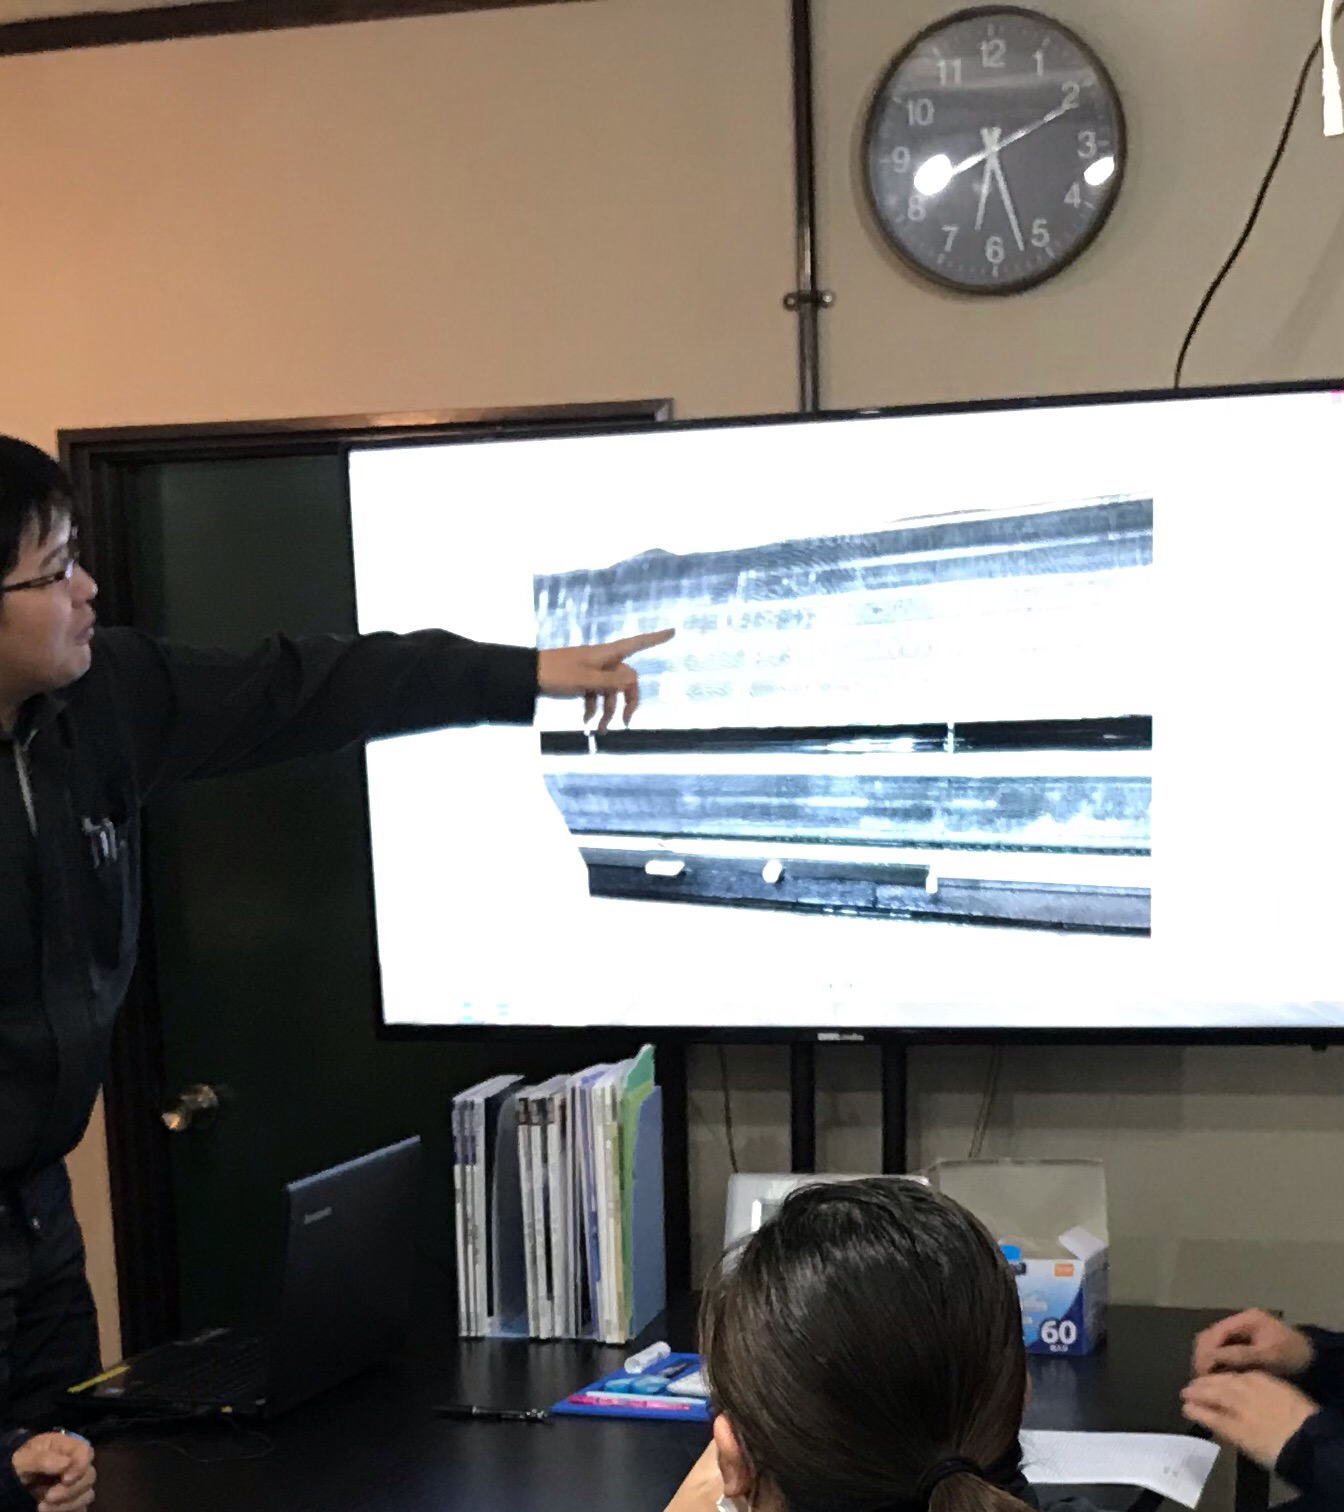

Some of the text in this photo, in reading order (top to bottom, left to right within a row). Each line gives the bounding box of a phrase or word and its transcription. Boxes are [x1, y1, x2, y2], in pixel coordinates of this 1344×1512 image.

[980, 38, 1006, 69] 12
[1032, 49, 1045, 77] 1
[936, 58, 963, 87] 11
[1060, 80, 1081, 109] 2
[906, 97, 936, 126] 10
[1076, 129, 1098, 159] 3
[890, 146, 912, 174] 9
[907, 195, 927, 223] 8
[1063, 181, 1082, 209] 4
[942, 224, 959, 252] 7
[1030, 216, 1051, 248] 5
[984, 235, 1005, 264] 6
[1040, 1319, 1077, 1345] 60
